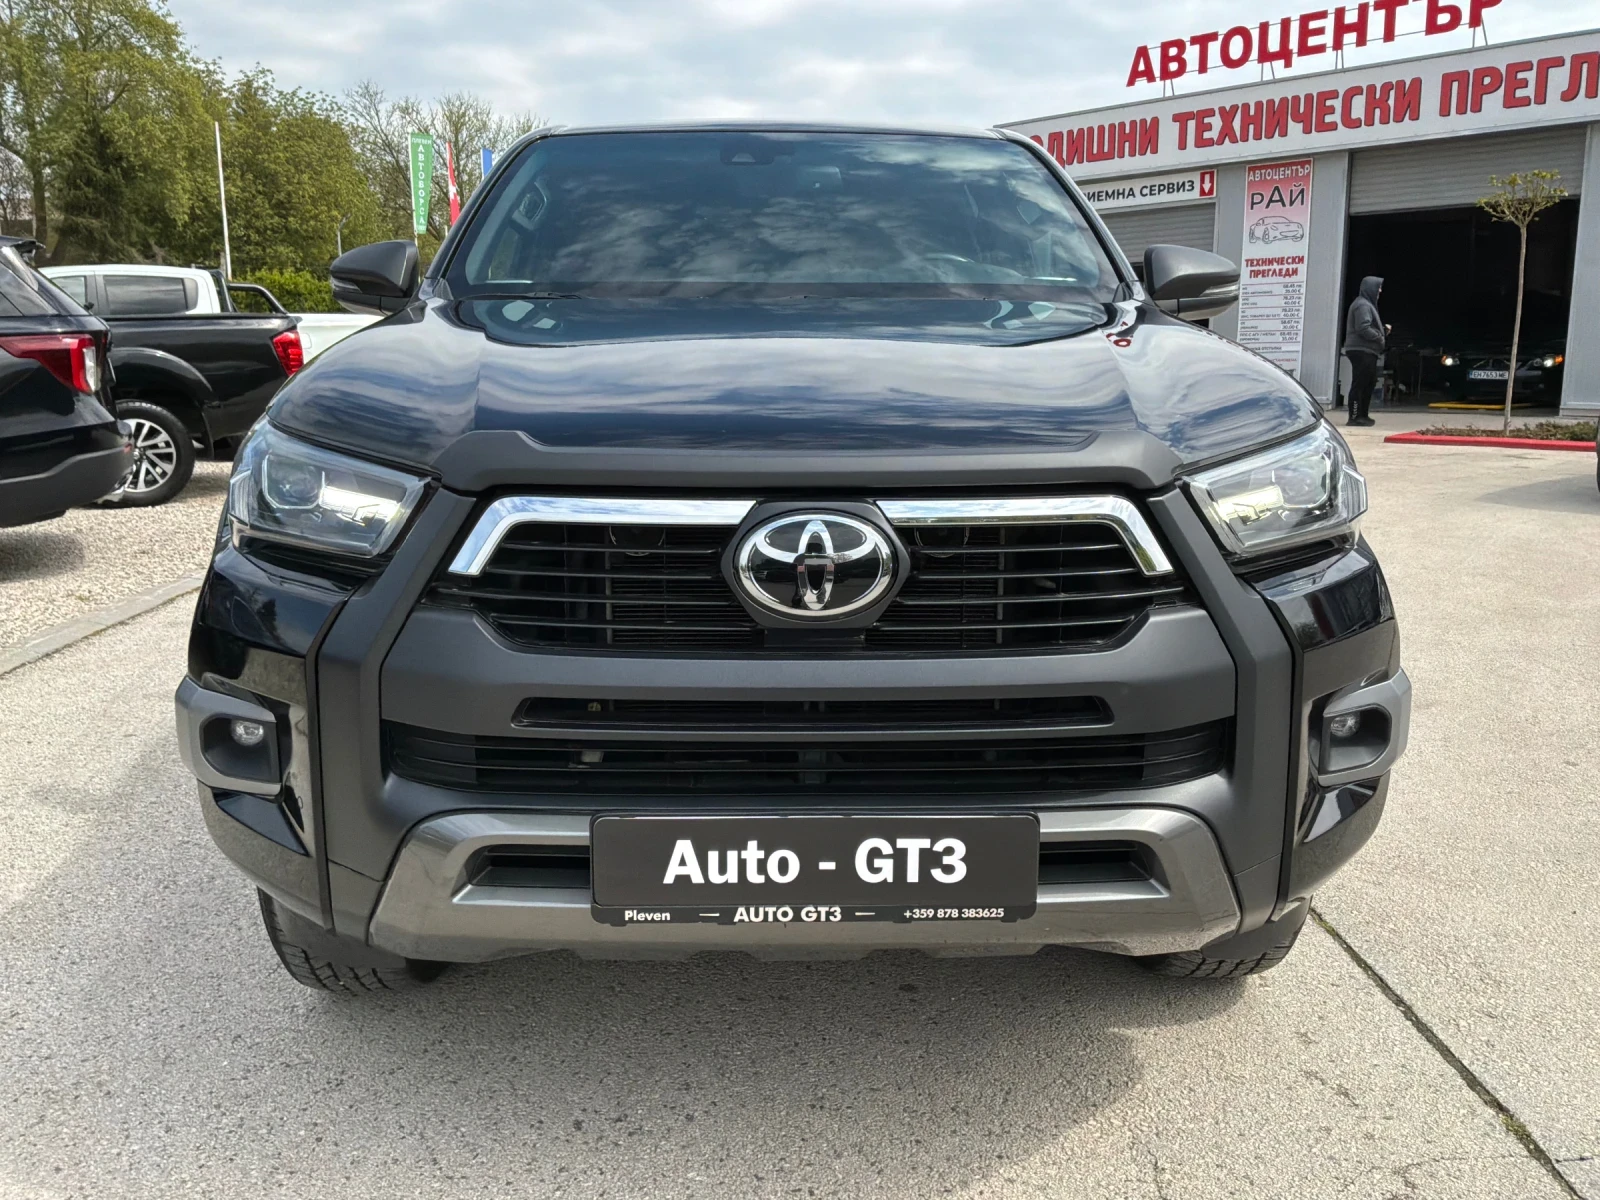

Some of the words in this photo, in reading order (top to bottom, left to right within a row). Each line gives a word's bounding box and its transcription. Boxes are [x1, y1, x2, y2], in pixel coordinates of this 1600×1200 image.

[1126, 0, 1500, 87] АВТОЦЕНТЪР
[1172, 77, 1422, 150] ТЕХНИЧЕСКИ
[1439, 51, 1600, 117] ПРЕГЛ
[1248, 164, 1311, 182] АВТОЦЕНТЪР
[1083, 187, 1136, 203] ИЕМНА
[1139, 180, 1195, 197] СЕРВИЗ
[1250, 183, 1305, 210] РАЙ
[1245, 255, 1305, 268] ТЕХНИЧЕСКИ
[1249, 267, 1299, 279] ПРЕГЛЕДИ
[663, 839, 800, 884] Auto
[818, 862, 836, 870] -
[854, 837, 968, 884] GT3
[624, 910, 671, 922] Pleven
[733, 907, 794, 923] AUTO
[800, 906, 842, 922] GT3
[903, 908, 934, 919] +359
[936, 908, 959, 919] 878
[961, 907, 1005, 918] 383625
